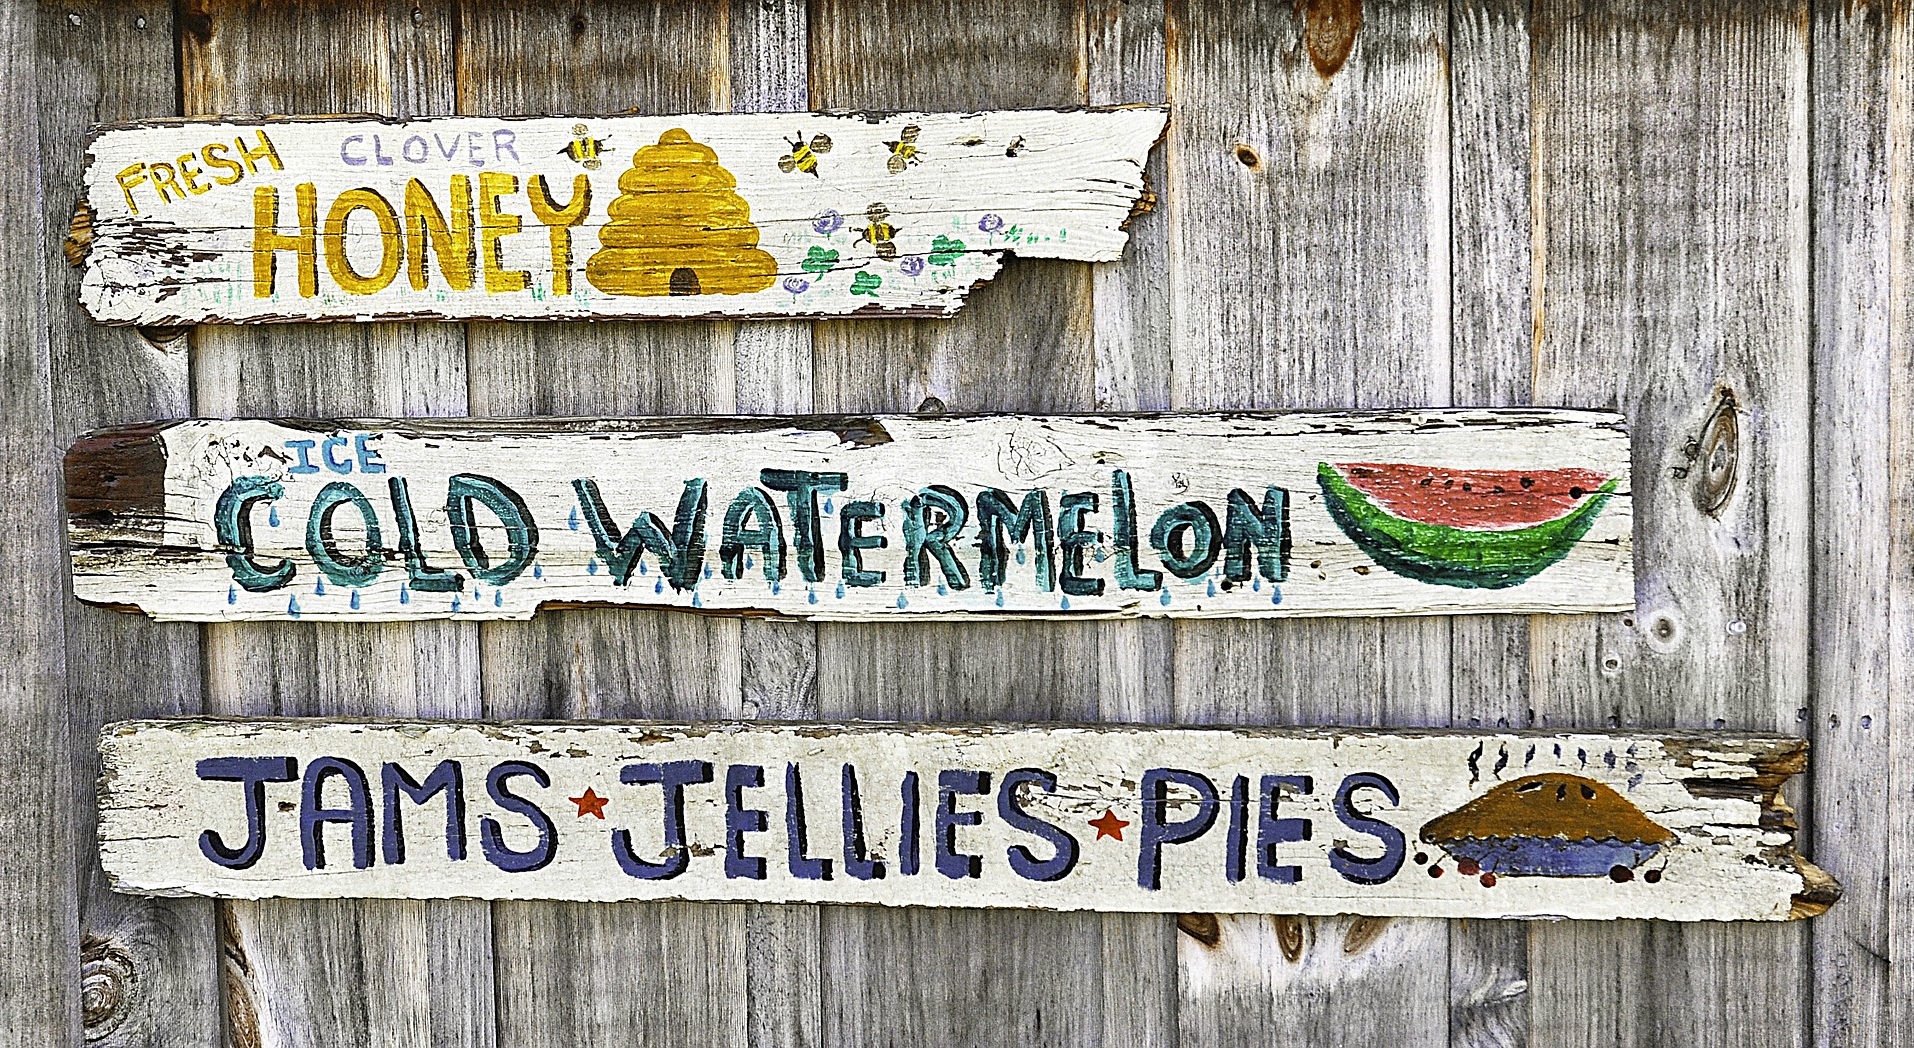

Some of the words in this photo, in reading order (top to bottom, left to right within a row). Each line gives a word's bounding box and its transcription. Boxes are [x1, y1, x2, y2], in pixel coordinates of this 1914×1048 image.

[115, 129, 284, 215] FRESH
[340, 129, 520, 167] CLOVER
[253, 172, 592, 298] HONEY
[285, 433, 387, 474] ICE
[214, 473, 540, 593] COLD
[571, 468, 1291, 596] WATERMELON
[196, 756, 558, 872] JAMS
[611, 760, 1080, 881] JELLIES
[1137, 767, 1407, 891] PIES
